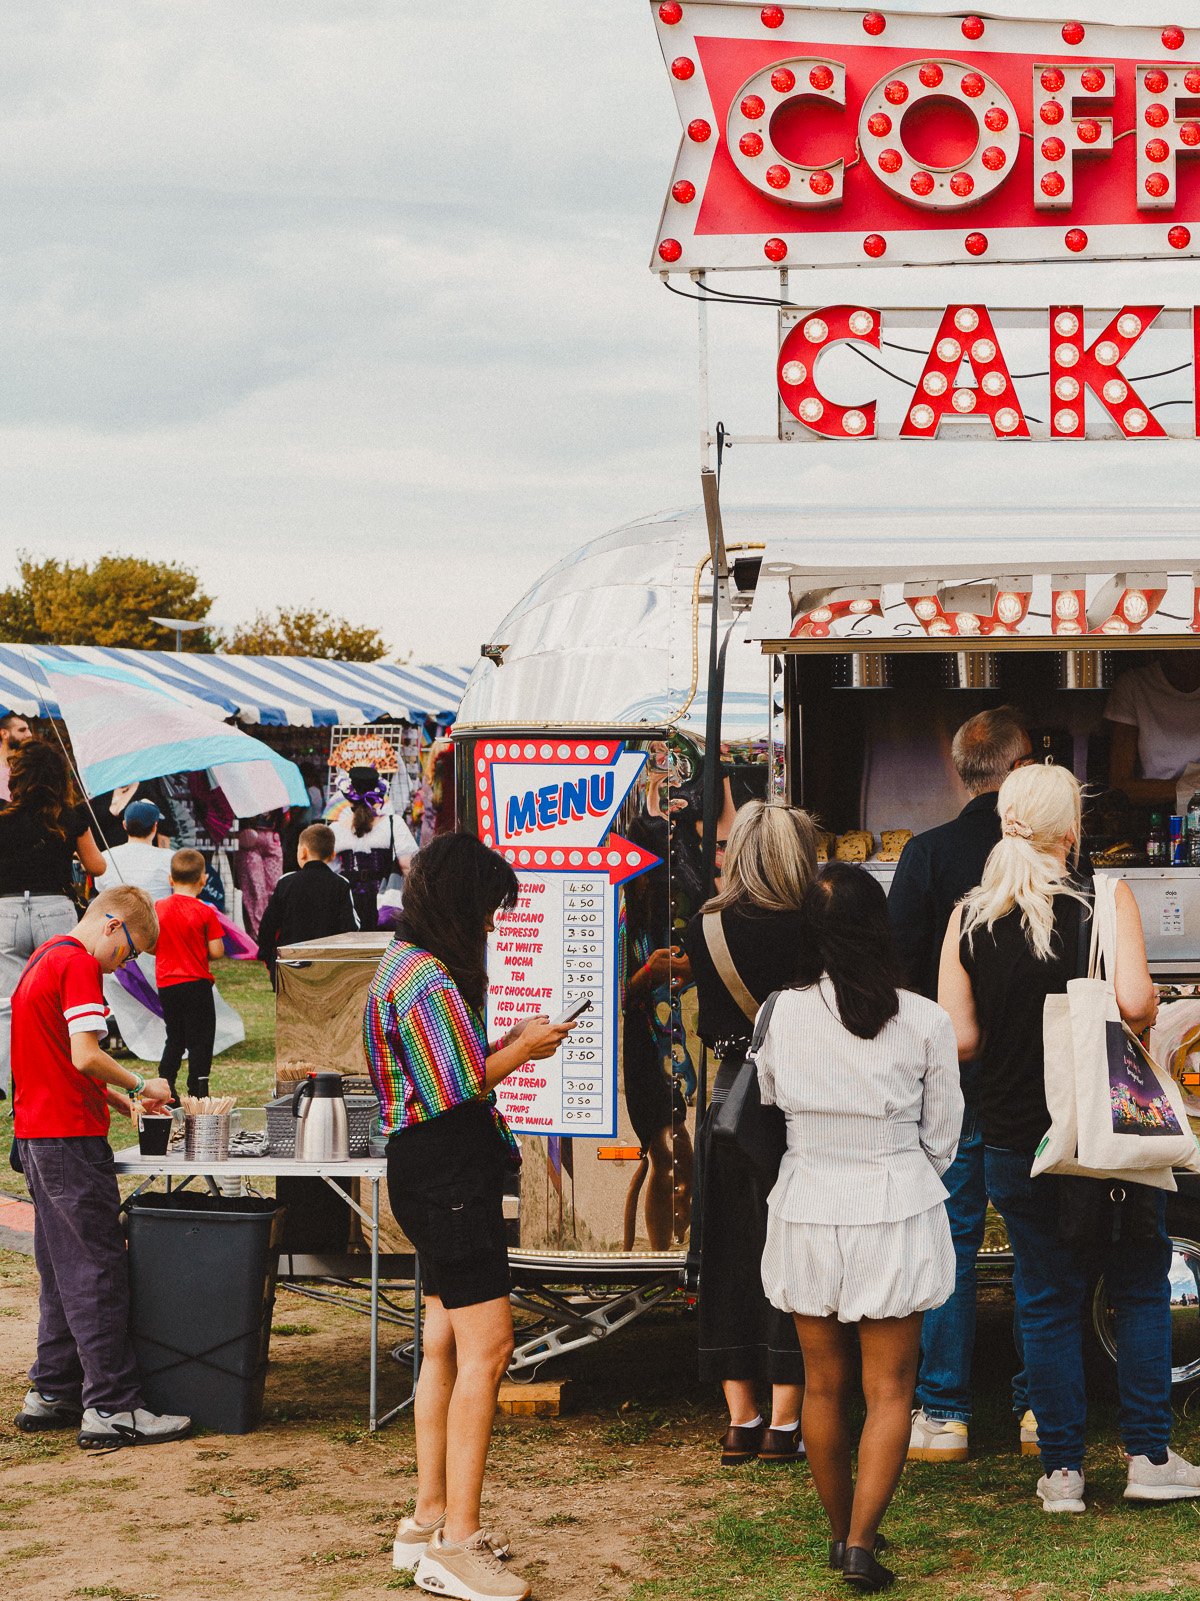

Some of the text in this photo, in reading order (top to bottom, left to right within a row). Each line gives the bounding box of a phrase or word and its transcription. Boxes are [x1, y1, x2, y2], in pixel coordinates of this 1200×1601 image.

[505, 771, 614, 839] MENU
[515, 897, 531, 908] TTE
[496, 912, 544, 923] AMERICANO
[499, 926, 540, 938] ESPRESSO
[496, 941, 543, 953] FLAT WHITE
[504, 956, 533, 967] MOCHA
[511, 971, 525, 981] TEA
[489, 985, 553, 998] HOT CHOCOLATE
[497, 1001, 541, 1013] ICED LATTE
[494, 1016, 512, 1027] COLD
[579, 1020, 594, 1029] 50
[516, 1063, 536, 1073] KIES
[518, 1078, 547, 1089] BREAD
[499, 1091, 537, 1102] EXTRA SHOT
[505, 1104, 530, 1113] SYRUPS
[514, 1116, 524, 1124] OR
[525, 1117, 553, 1126] VANILLA
